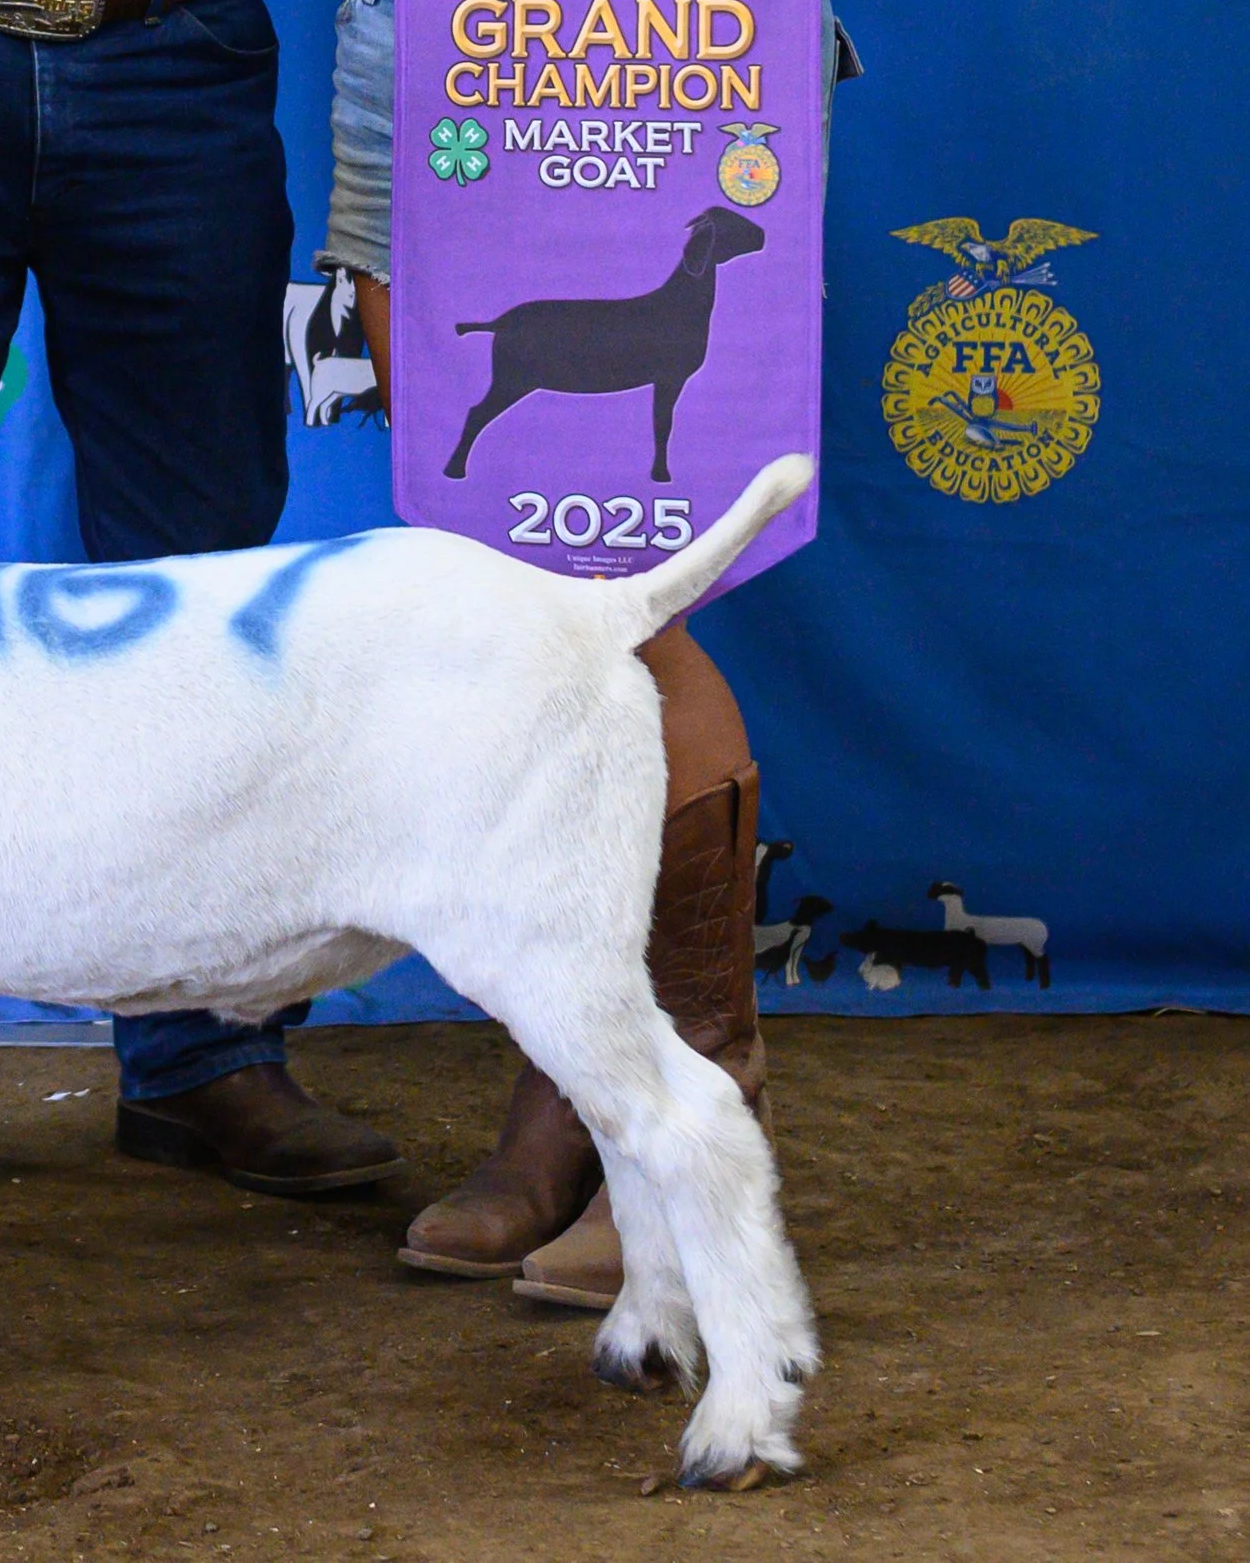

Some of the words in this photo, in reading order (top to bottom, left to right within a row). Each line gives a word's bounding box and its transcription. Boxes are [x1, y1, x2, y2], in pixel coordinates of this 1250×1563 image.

[445, 61, 762, 111] CHAMPION
[437, 127, 453, 143] H
[464, 127, 480, 143] H
[503, 118, 702, 153] MARKET
[436, 155, 451, 171] H
[466, 156, 482, 171] H
[539, 157, 664, 189] GOAT
[916, 312, 1069, 379] AGRICULTURAL
[952, 341, 1036, 374] FFA
[927, 428, 1056, 473] EDUCATION
[508, 491, 693, 551] 2025
